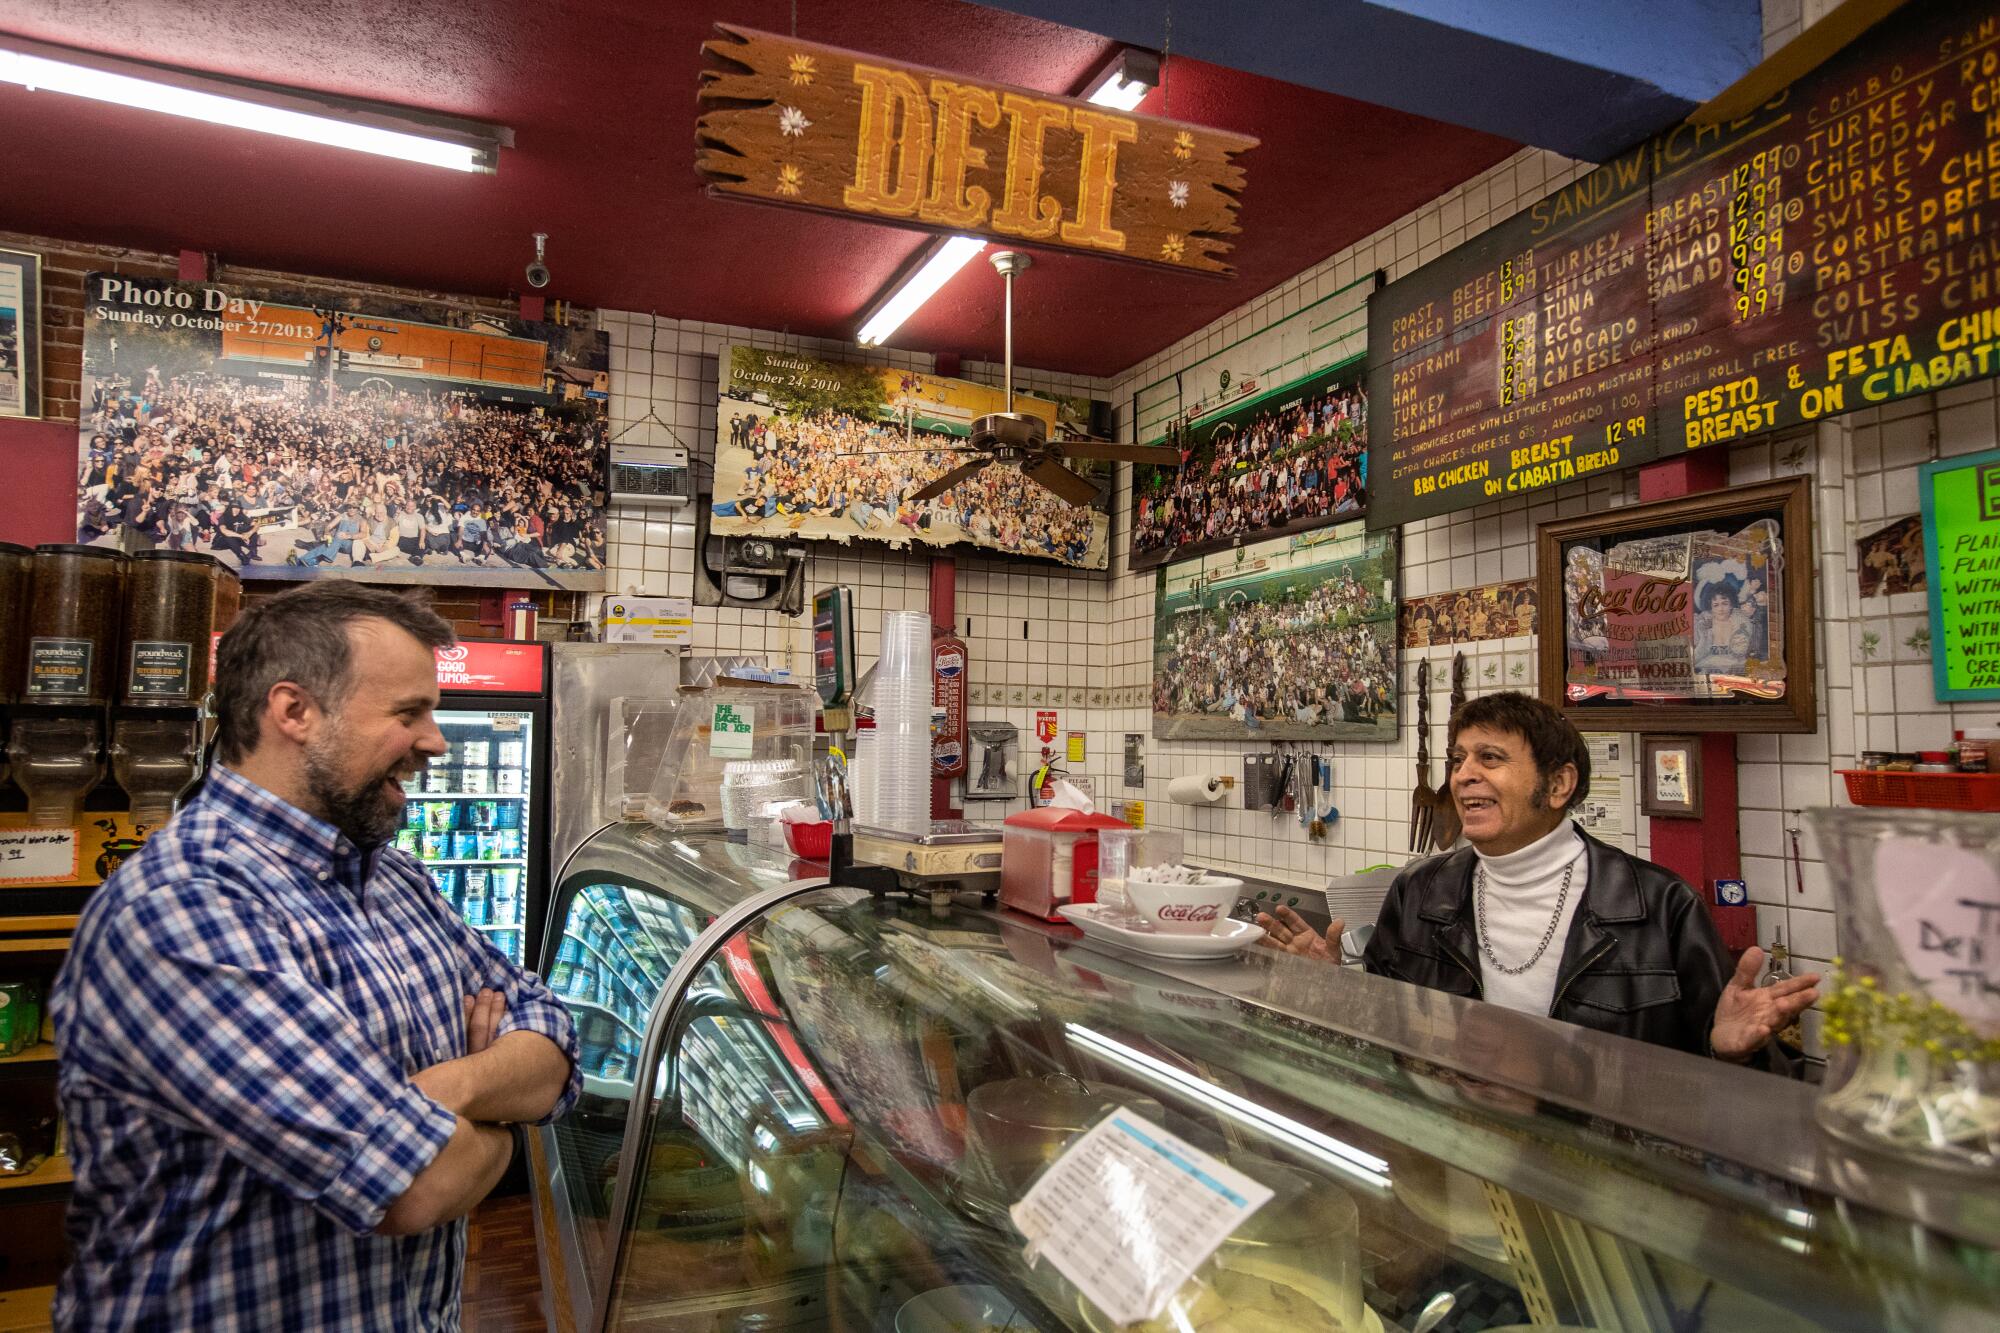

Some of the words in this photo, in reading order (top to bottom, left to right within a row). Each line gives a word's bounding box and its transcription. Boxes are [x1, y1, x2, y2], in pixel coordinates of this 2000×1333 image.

[1805, 80, 1934, 156] TURKEY
[1808, 65, 1903, 124] COMBO
[844, 63, 1138, 251] DELI
[1806, 100, 1955, 185] CHEDDAR
[1808, 138, 1936, 210] TURKEY
[1541, 231, 1620, 282] TURKEY
[1645, 174, 1729, 234] BREAST
[1812, 178, 1912, 238] SWISS
[1543, 246, 1635, 303] CHICKEN
[1644, 208, 1719, 260] SALAD
[1544, 289, 1594, 323] TUNA
[1646, 233, 1721, 281] SALAD
[1816, 212, 1980, 291] PASTRAMI
[95, 306, 165, 328] Sunday
[171, 313, 244, 333] October
[248, 320, 314, 339] 27/2013
[100, 278, 192, 310] Photo
[202, 288, 264, 321] Day
[1392, 303, 1434, 336] ROAST
[1453, 271, 1496, 306] BEEF
[1500, 249, 1534, 283] 13.99
[1392, 317, 1444, 353] CORNED
[1453, 292, 1496, 325] BEEF
[1500, 269, 1536, 306] 13.99
[1544, 316, 1582, 347] EGG
[1648, 257, 1722, 303] SALAD
[1812, 272, 1897, 318] COLE
[1817, 294, 1920, 348] SWISS
[764, 355, 812, 373] Sunday
[1393, 349, 1460, 386] PASTRAMI
[1543, 343, 1623, 388] CHEESE
[1663, 317, 1698, 341] KIND)
[1544, 317, 1637, 366] AVOCADO
[734, 368, 785, 384] October
[787, 375, 806, 388] 24,
[811, 378, 841, 392] 2010
[1393, 385, 1417, 408] HAM
[1684, 376, 1758, 420] PESTO
[1827, 334, 1912, 381] FETA
[1393, 394, 1444, 425] TURKEY
[1393, 449, 1407, 461] ALL
[1411, 433, 1454, 454] SANDWICHES
[1456, 425, 1476, 440] COME
[1480, 417, 1500, 430] WITH
[1598, 365, 1652, 391] MUSTARD
[1393, 463, 1419, 479] EXTRA
[1552, 405, 1603, 430] AVOCADO
[1647, 371, 1700, 401] FRENCH
[1708, 359, 1744, 380] ROLL
[1393, 412, 1442, 442] SALAMI
[1685, 400, 1779, 448] BREAST
[1800, 384, 1844, 419] ON
[1414, 475, 1435, 496] BBQ
[1438, 460, 1489, 489] CHICKEN
[1511, 435, 1574, 470] BREAST
[1606, 416, 1646, 446] 12.99
[1484, 477, 1501, 496] ON
[1506, 458, 1575, 492] CIABATTA
[1576, 447, 1620, 473] BREAD
[438, 661, 465, 672] GOOD
[715, 713, 742, 723] BAGEL
[716, 704, 732, 714] THE
